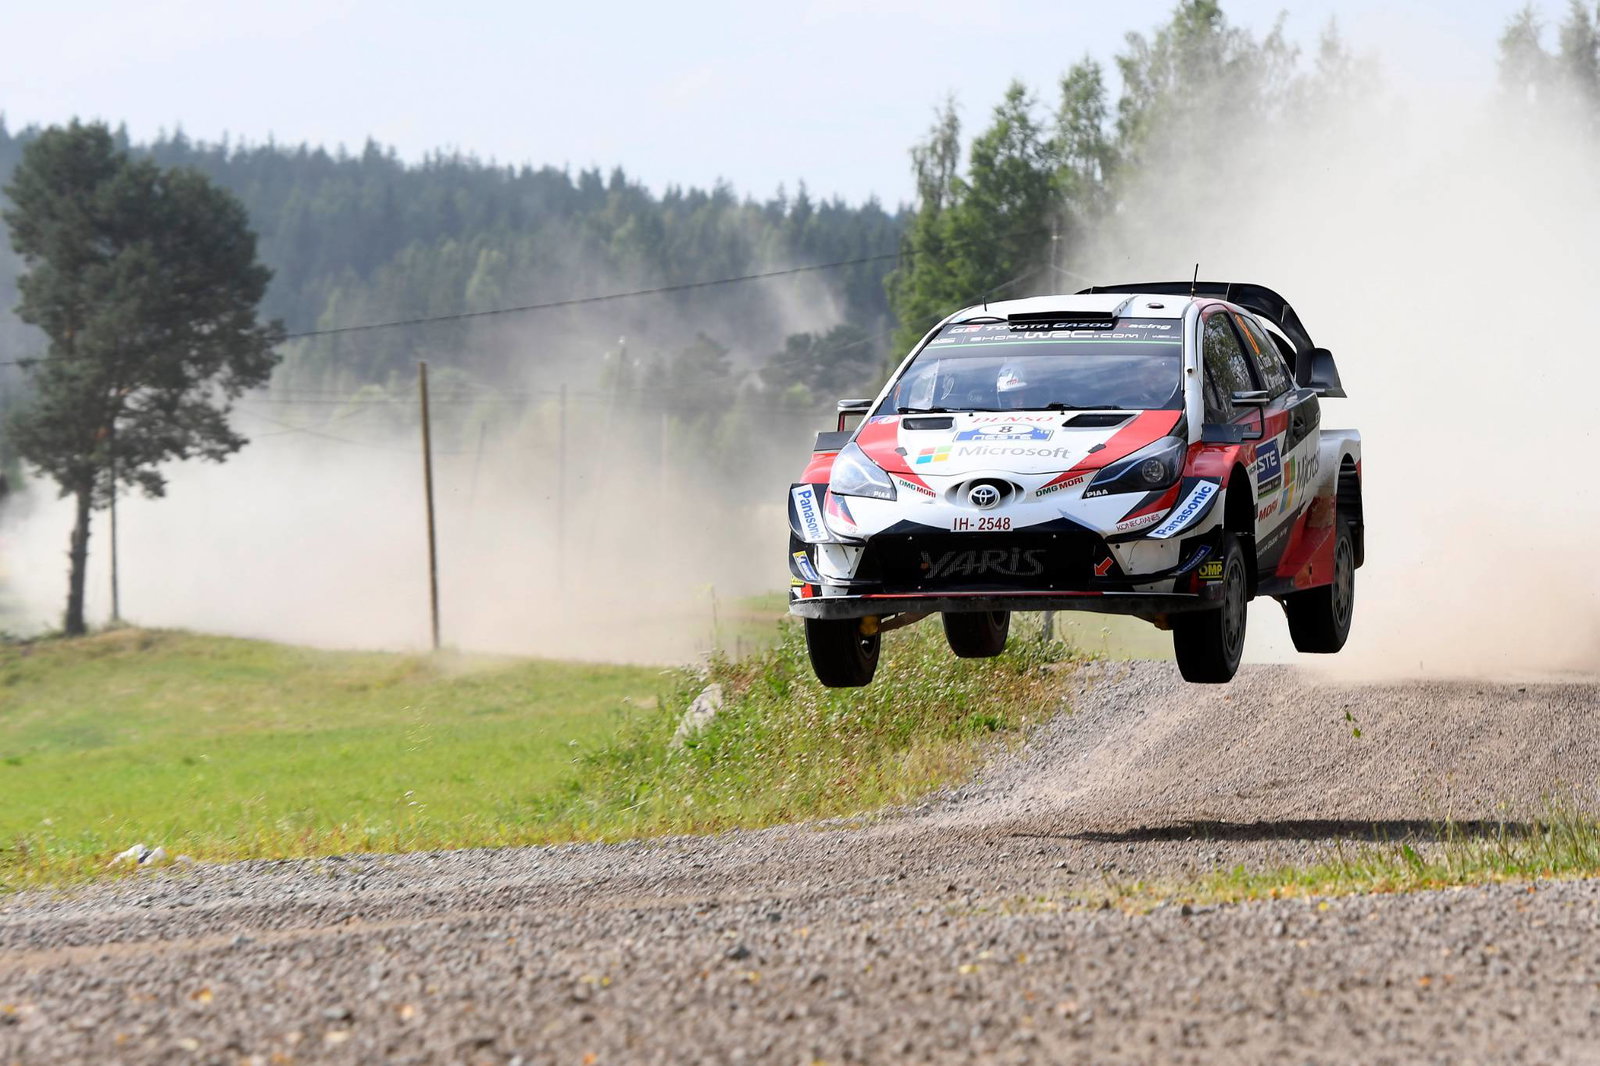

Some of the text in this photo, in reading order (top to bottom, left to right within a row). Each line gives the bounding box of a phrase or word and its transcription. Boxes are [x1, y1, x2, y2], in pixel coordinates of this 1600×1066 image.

[986, 323, 1049, 331] TOYOTA
[1118, 322, 1171, 330] Racing
[998, 425, 1013, 433] 8
[958, 445, 1071, 459] Microsoft
[1256, 449, 1277, 474] STE
[873, 490, 891, 499] PIAA
[899, 480, 937, 498] DMG MORI
[1035, 476, 1084, 498] DMG MORI
[1086, 489, 1109, 498] PIAA
[797, 489, 822, 540] Panasonic
[1154, 485, 1212, 536] Panasonic
[978, 517, 1011, 531] 2548
[1115, 513, 1161, 532] KONECRANES
[920, 547, 1048, 579] YARIS
[1198, 564, 1223, 576] OMP
